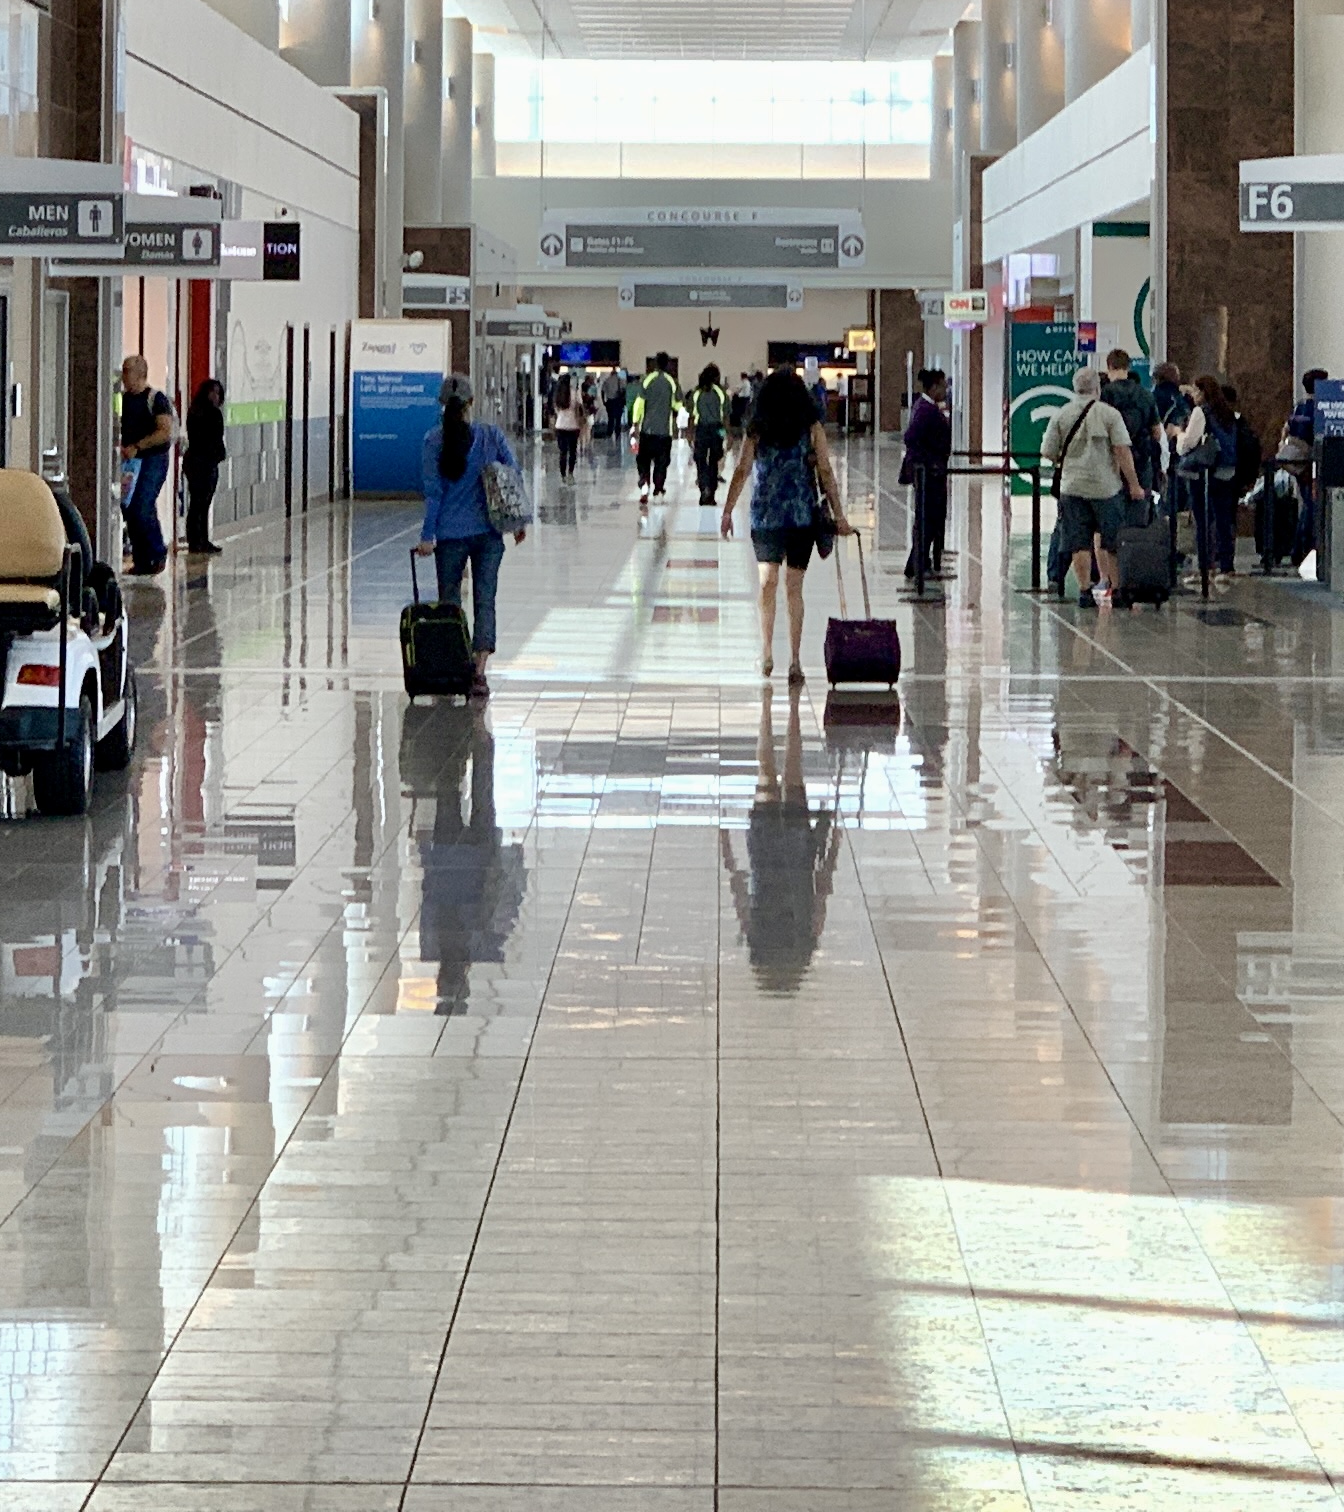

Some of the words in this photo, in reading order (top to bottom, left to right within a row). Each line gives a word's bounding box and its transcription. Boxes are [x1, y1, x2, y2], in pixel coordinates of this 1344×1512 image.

[1247, 183, 1294, 220] F6
[28, 205, 69, 221] MEN
[647, 210, 740, 222] CONCOURSE
[8, 224, 69, 238] Caballeros
[446, 287, 466, 305] F5
[949, 298, 969, 310] CNN
[1016, 350, 1051, 363] HOW
[1016, 363, 1038, 376] WE
